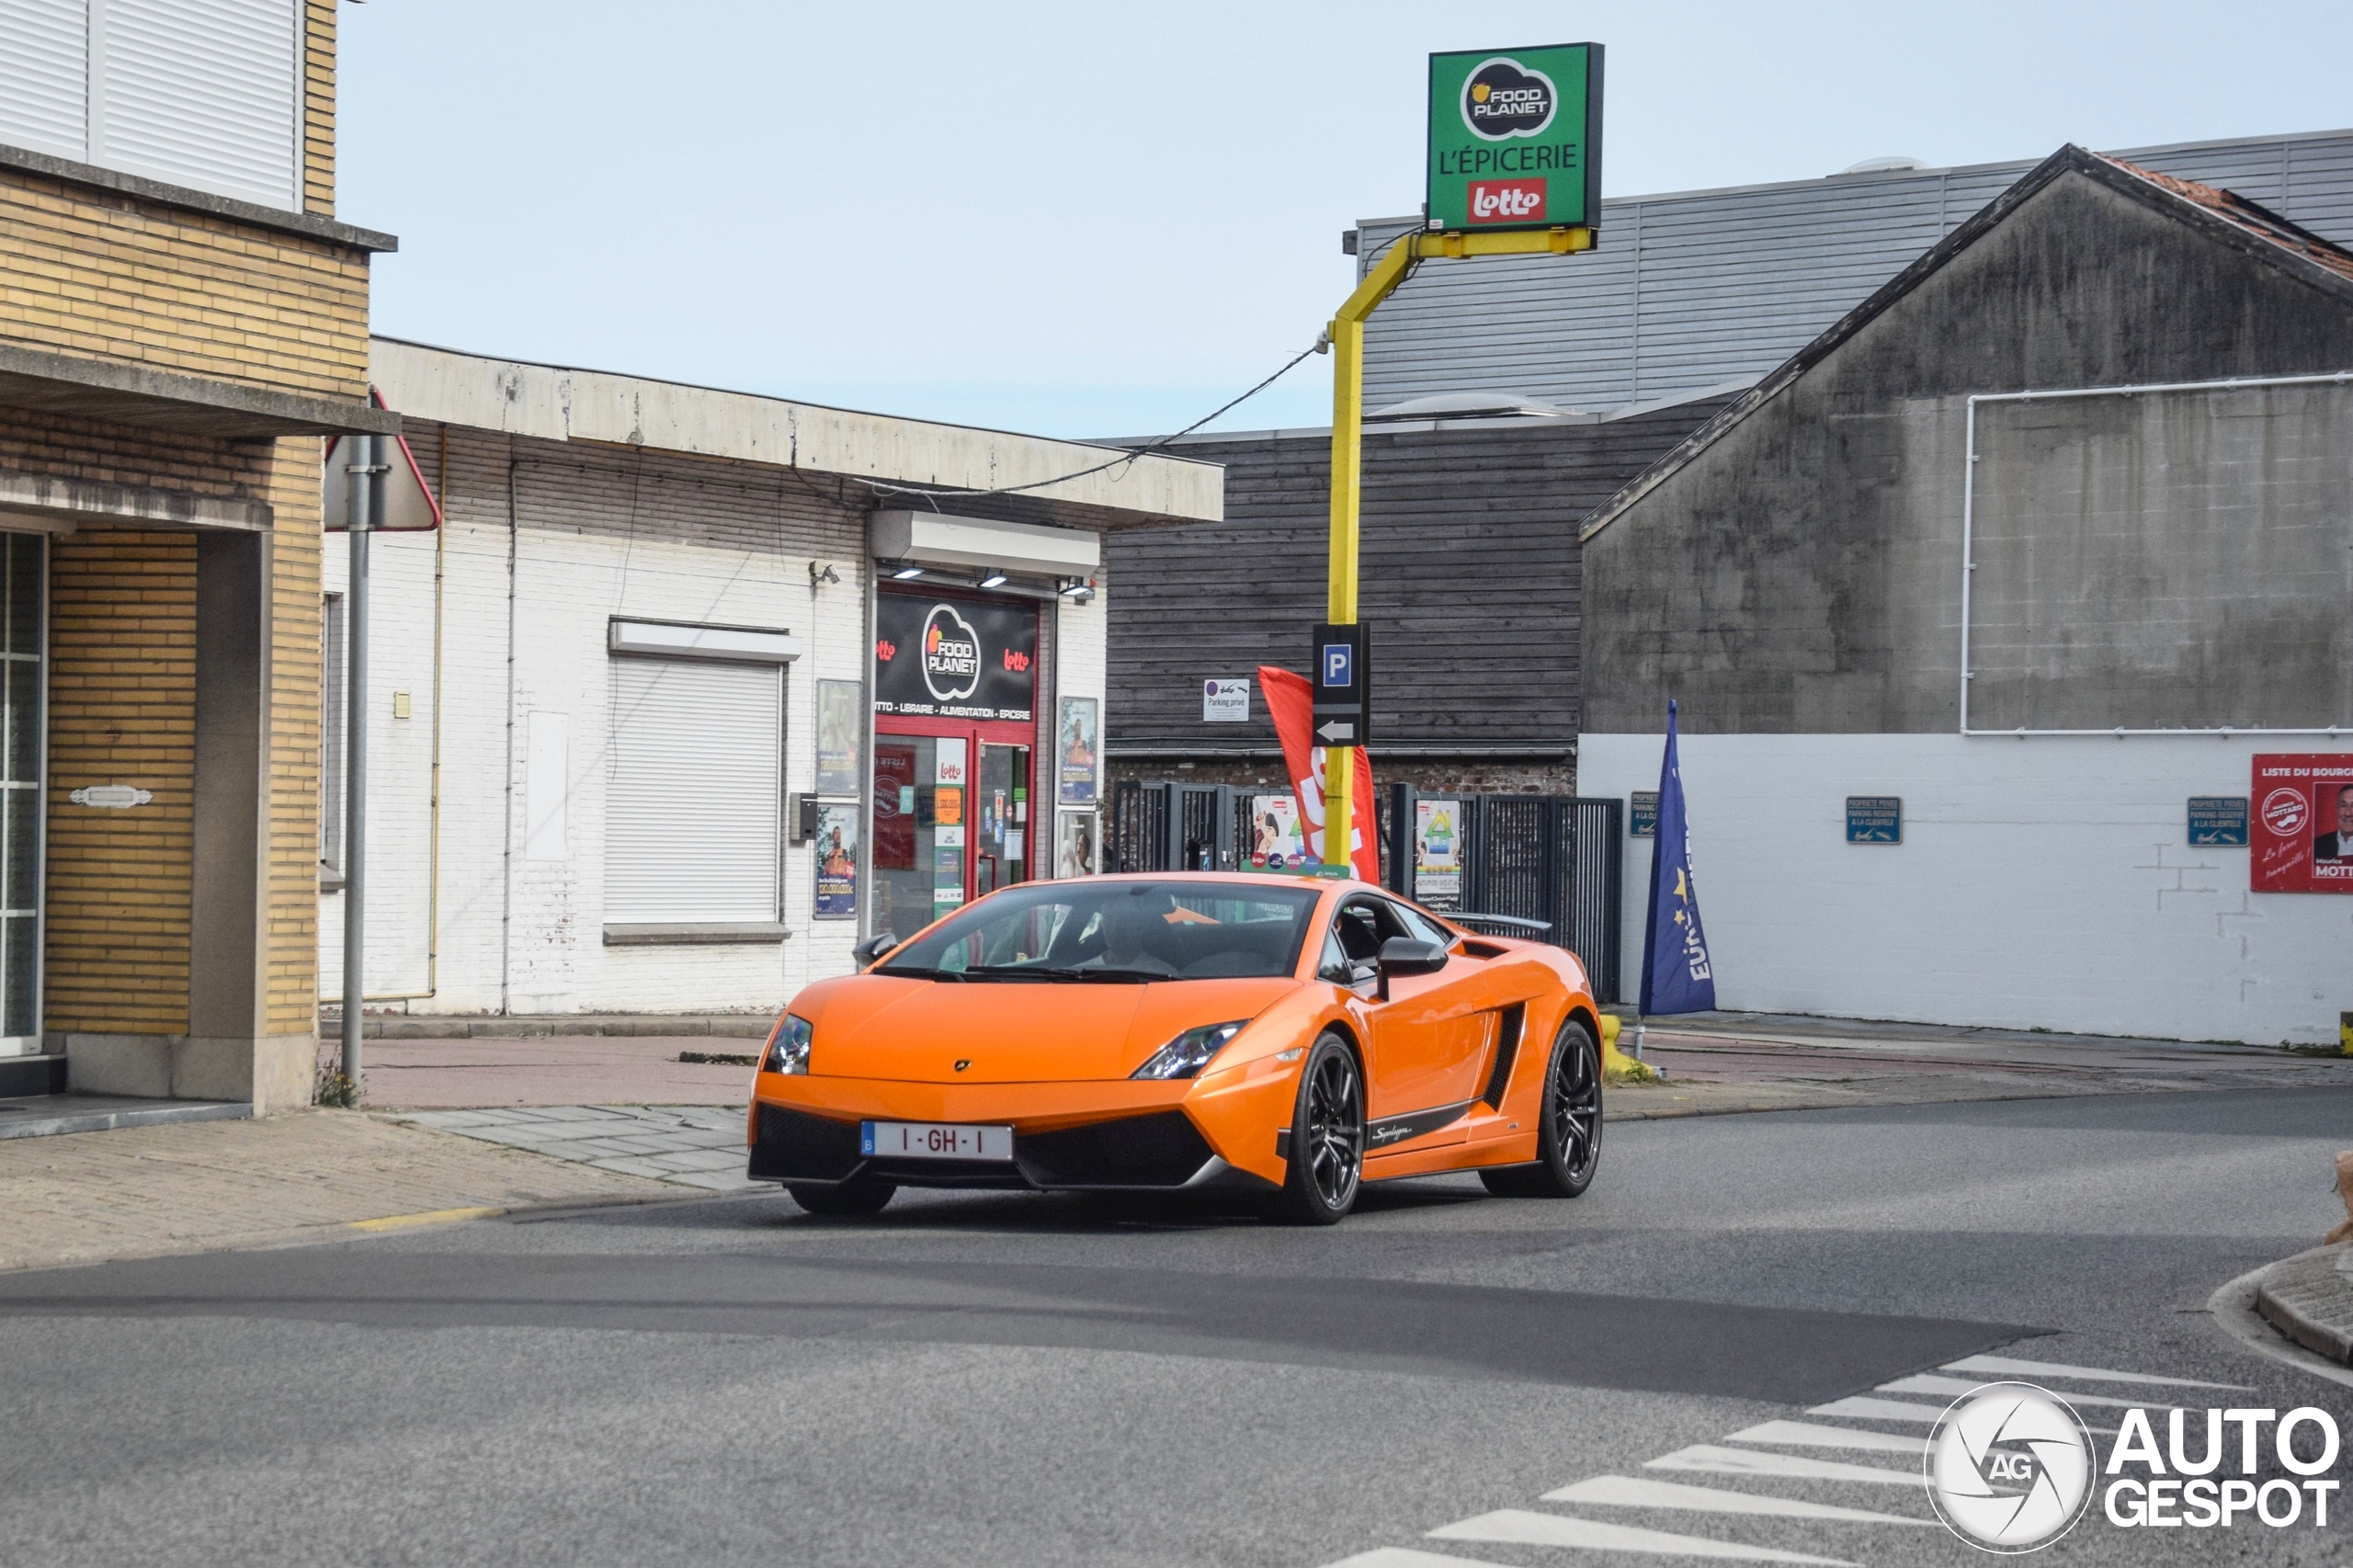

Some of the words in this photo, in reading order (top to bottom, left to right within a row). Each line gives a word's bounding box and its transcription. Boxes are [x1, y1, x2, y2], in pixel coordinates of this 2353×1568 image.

[1490, 89, 1541, 103] FOOD
[1474, 101, 1548, 117] PLANET
[1439, 144, 1576, 175] L'ÉPICERIE
[938, 642, 972, 657] FOOD
[928, 656, 976, 673] PLANET
[1329, 653, 1347, 677] P
[1209, 698, 1230, 708] Parking
[1230, 698, 1245, 707] privé
[899, 702, 934, 714] LIBRAIRIE
[939, 706, 994, 718] ALIMENTATION
[999, 710, 1030, 720] EPICERIE
[2262, 767, 2290, 777] LISTE
[2293, 767, 2310, 777] DU
[2313, 767, 2353, 777] BOURG
[2266, 804, 2303, 819] MOTTARD
[2315, 866, 2353, 877] MOTT
[864, 1140, 872, 1151] B
